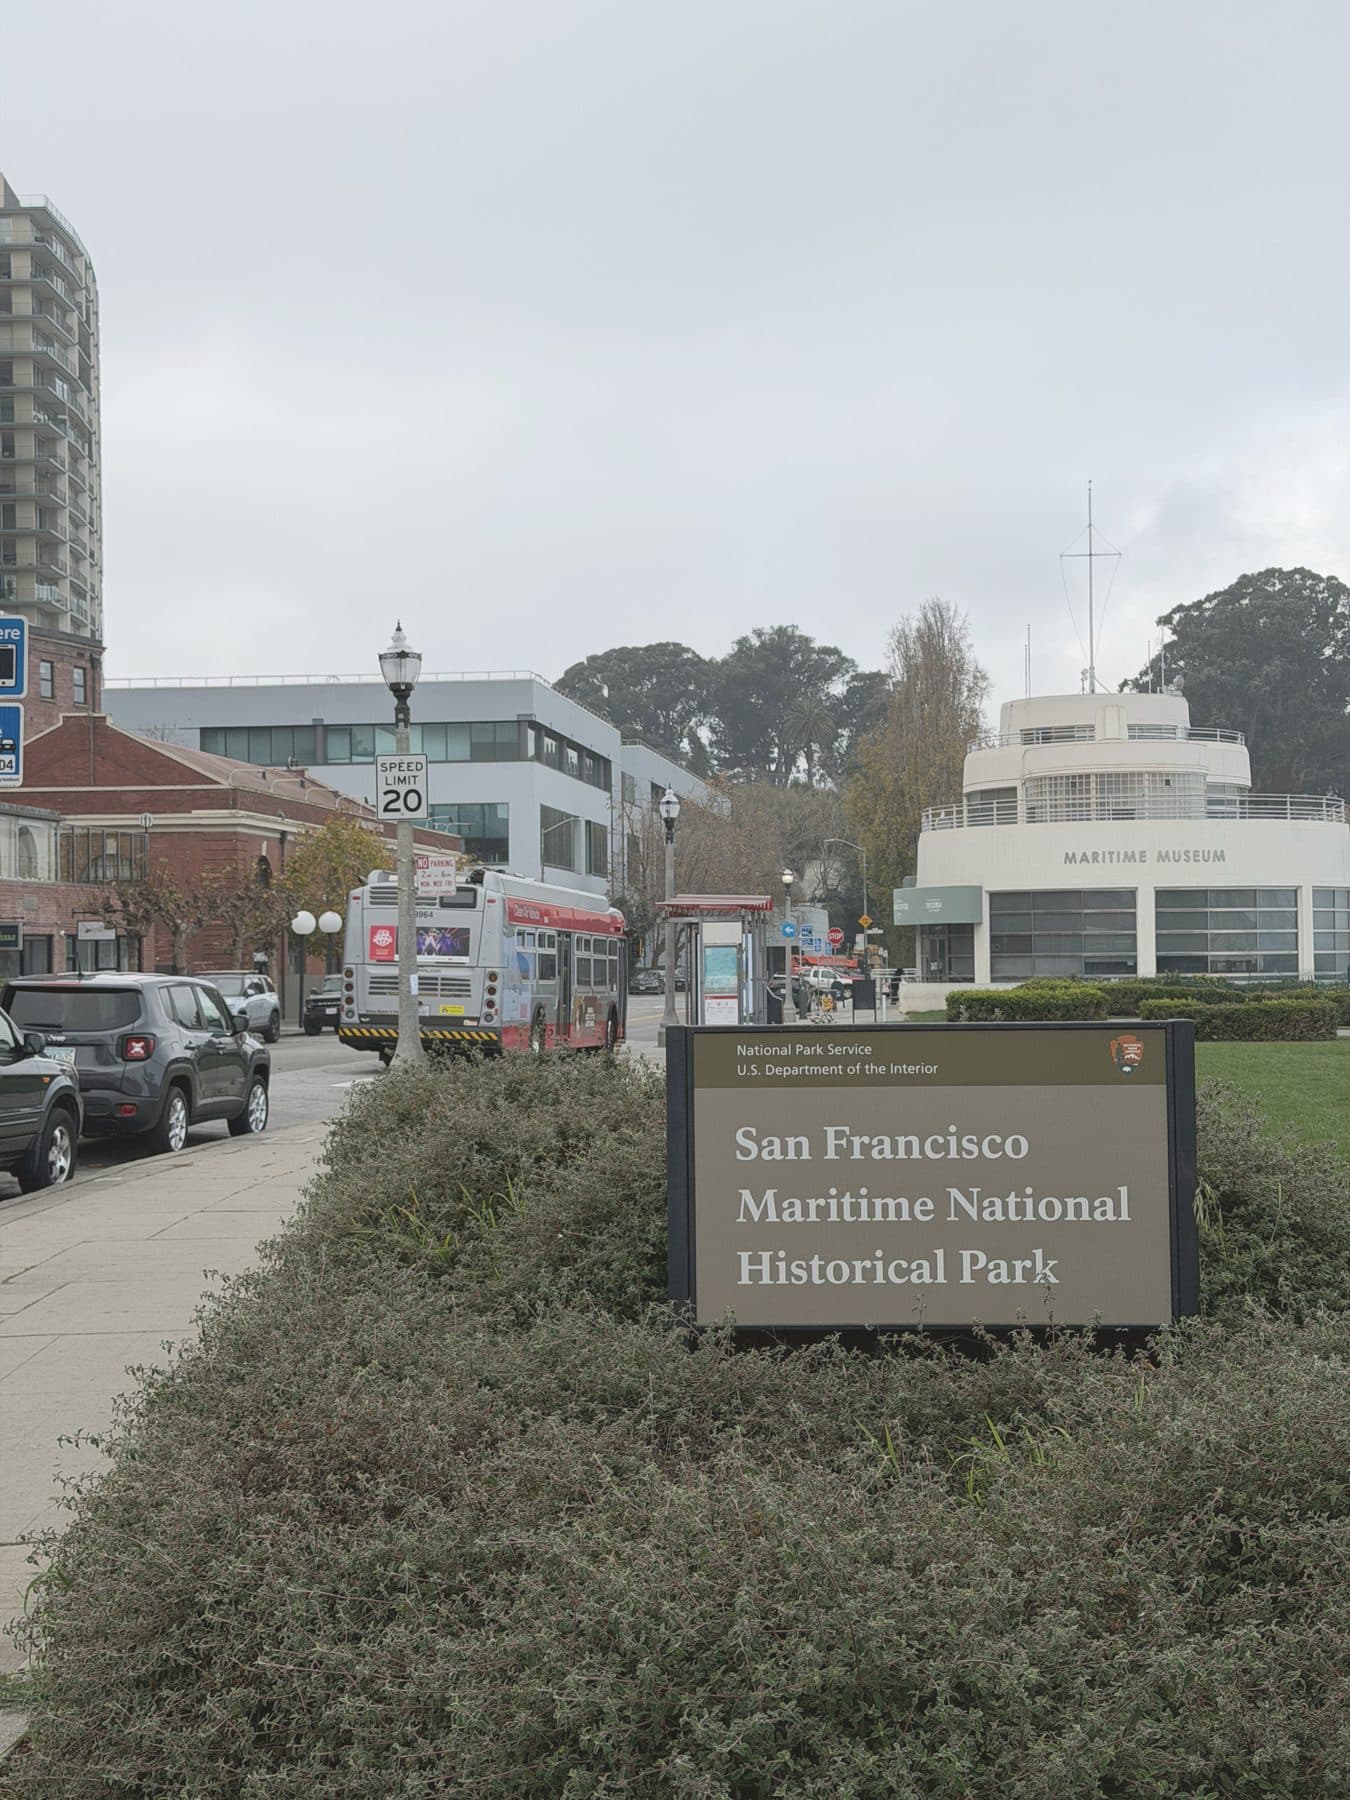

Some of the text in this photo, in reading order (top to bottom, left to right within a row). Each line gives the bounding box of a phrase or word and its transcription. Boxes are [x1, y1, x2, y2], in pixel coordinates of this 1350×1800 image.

[380, 761, 424, 773] SPEED
[385, 775, 419, 786] LIMIT
[382, 788, 423, 813] 20
[417, 858, 428, 868] NO
[1063, 849, 1227, 865] MARITIME MUSEUM
[828, 932, 842, 940] STOP
[736, 1043, 873, 1056] National Park Service
[736, 1062, 939, 1078] U.S. Department of the Interior
[735, 1124, 1029, 1161] San Francisco
[735, 1186, 1132, 1223] Maritime National
[736, 1248, 1060, 1285] Historical Park
